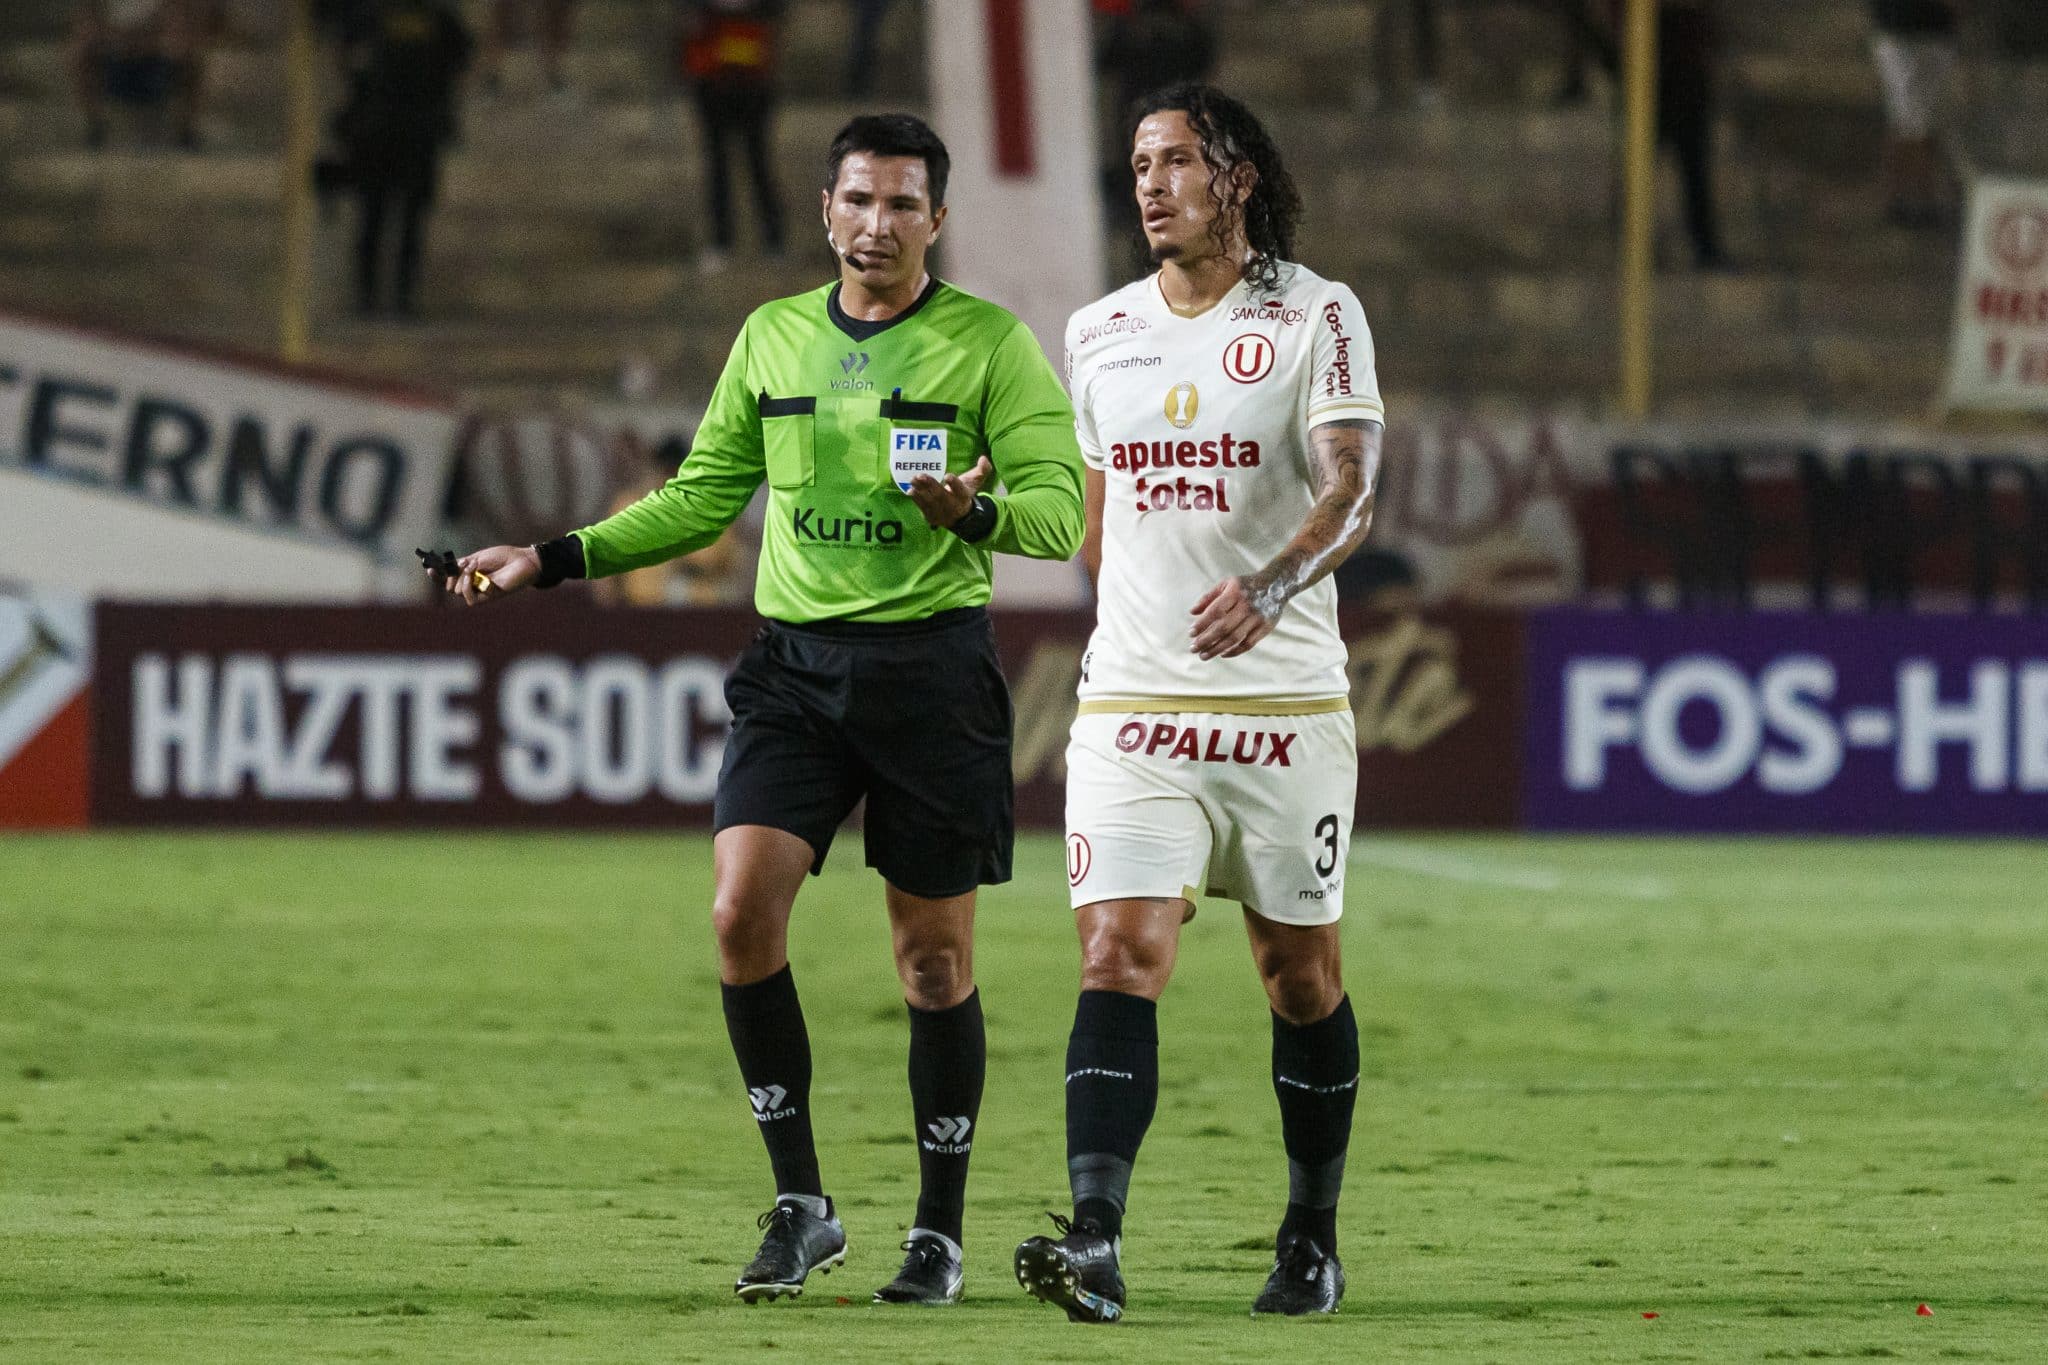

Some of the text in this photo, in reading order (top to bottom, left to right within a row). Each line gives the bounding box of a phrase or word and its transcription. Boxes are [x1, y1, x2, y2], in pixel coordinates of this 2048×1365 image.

[1097, 356, 1162, 373] marathon
[1324, 301, 1352, 395] Fos-hepan
[830, 378, 874, 392] walon
[1326, 371, 1336, 398] Forte
[0, 362, 408, 545] ERNO
[895, 434, 942, 451] FIFA
[1110, 433, 1261, 476] apuesta
[895, 461, 942, 472] REFEREE
[1135, 477, 1231, 513] total
[793, 507, 904, 545] Kuria
[132, 653, 482, 800] HAZTE
[1115, 721, 1298, 767] OPALUX
[1315, 813, 1339, 878] 3
[923, 1140, 971, 1155] walon
